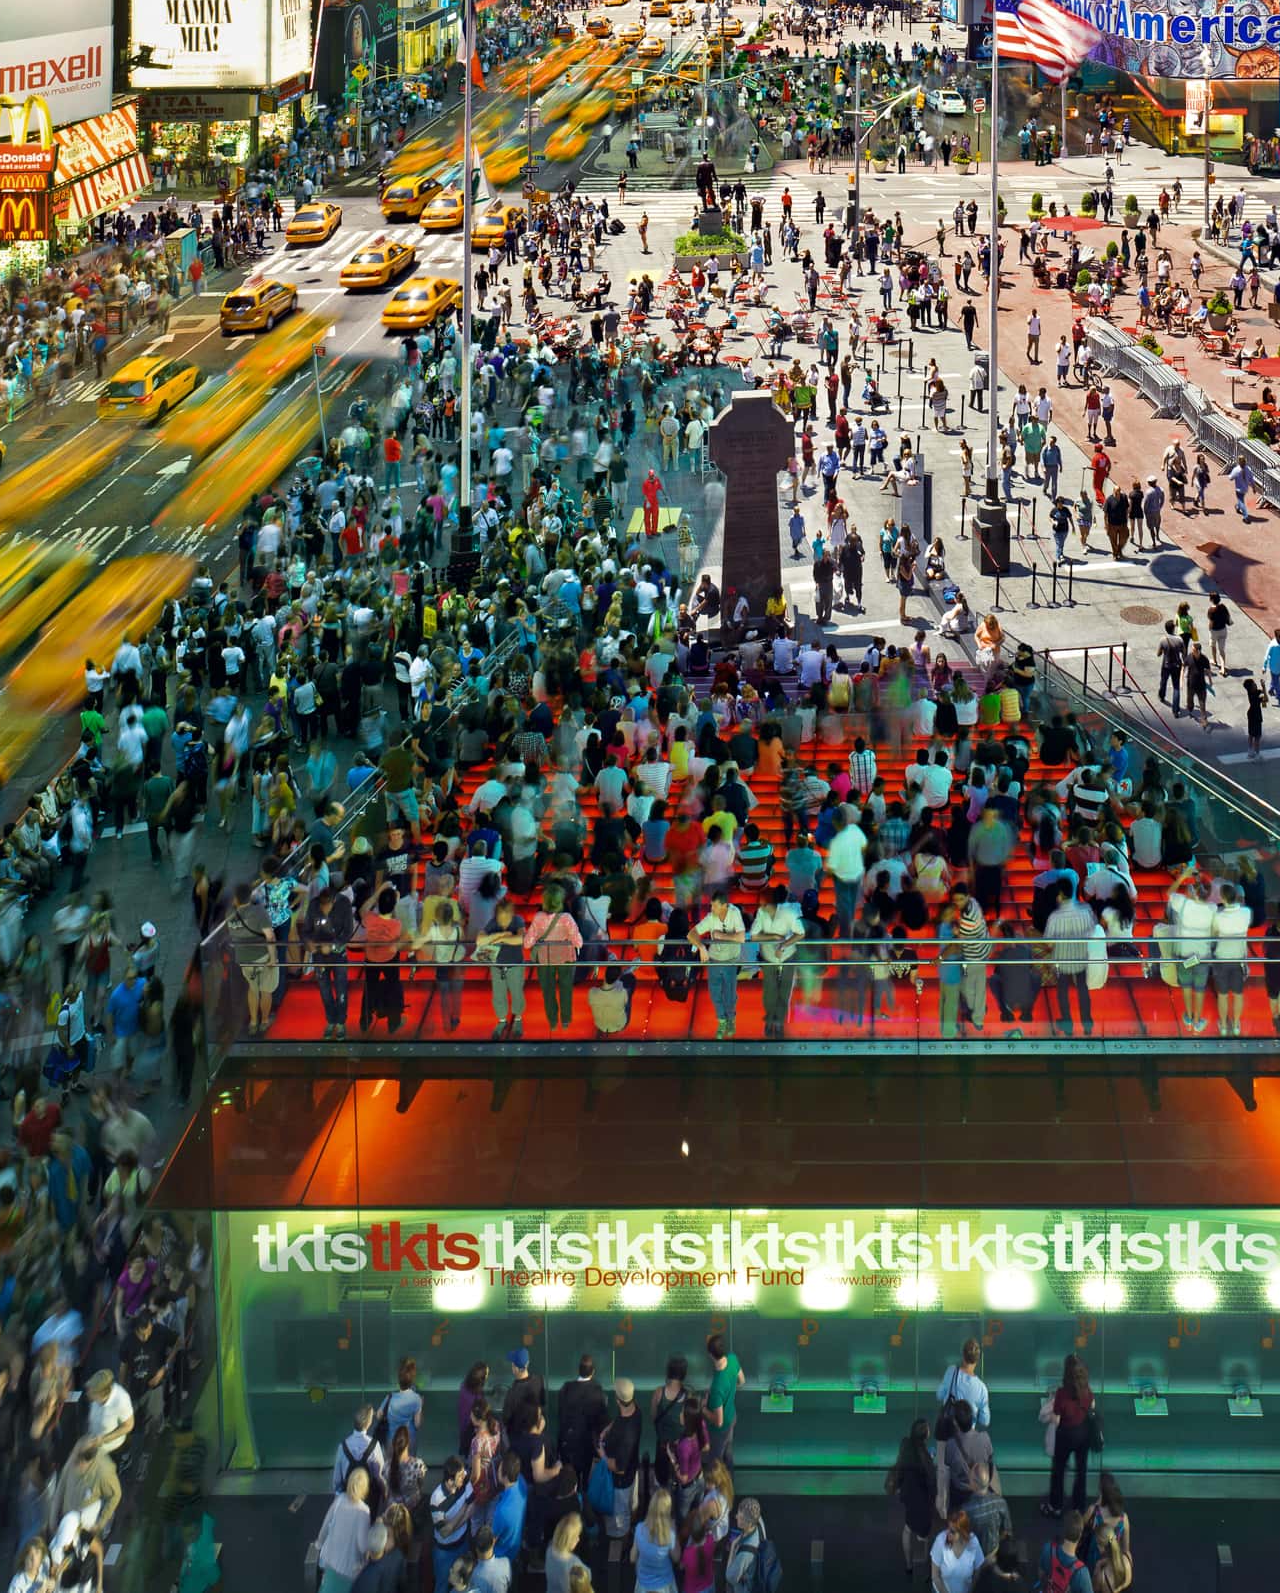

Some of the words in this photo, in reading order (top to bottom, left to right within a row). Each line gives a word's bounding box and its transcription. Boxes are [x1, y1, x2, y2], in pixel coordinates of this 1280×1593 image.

[179, 24, 219, 53] MIA!
[484, 1266, 576, 1287] Theatre
[583, 1266, 738, 1292] Development
[746, 1266, 805, 1287] Fund
